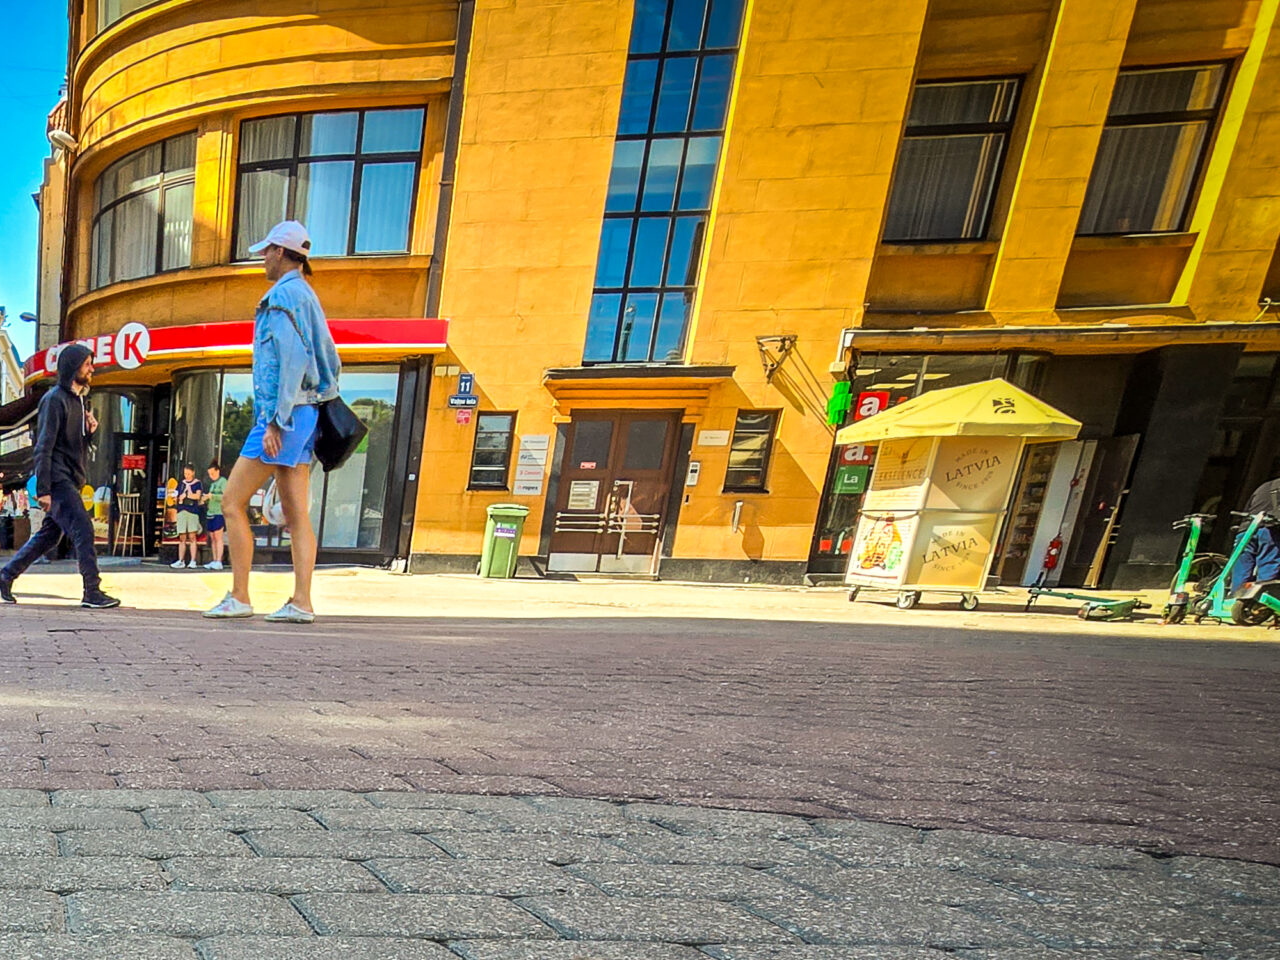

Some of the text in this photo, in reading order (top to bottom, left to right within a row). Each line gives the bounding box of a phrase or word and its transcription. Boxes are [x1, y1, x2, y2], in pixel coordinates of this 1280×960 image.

[123, 331, 144, 364] K
[460, 381, 471, 393] 11
[843, 473, 859, 484] La
[945, 455, 1002, 482] LATVIA
[922, 537, 979, 564] LATVIA
